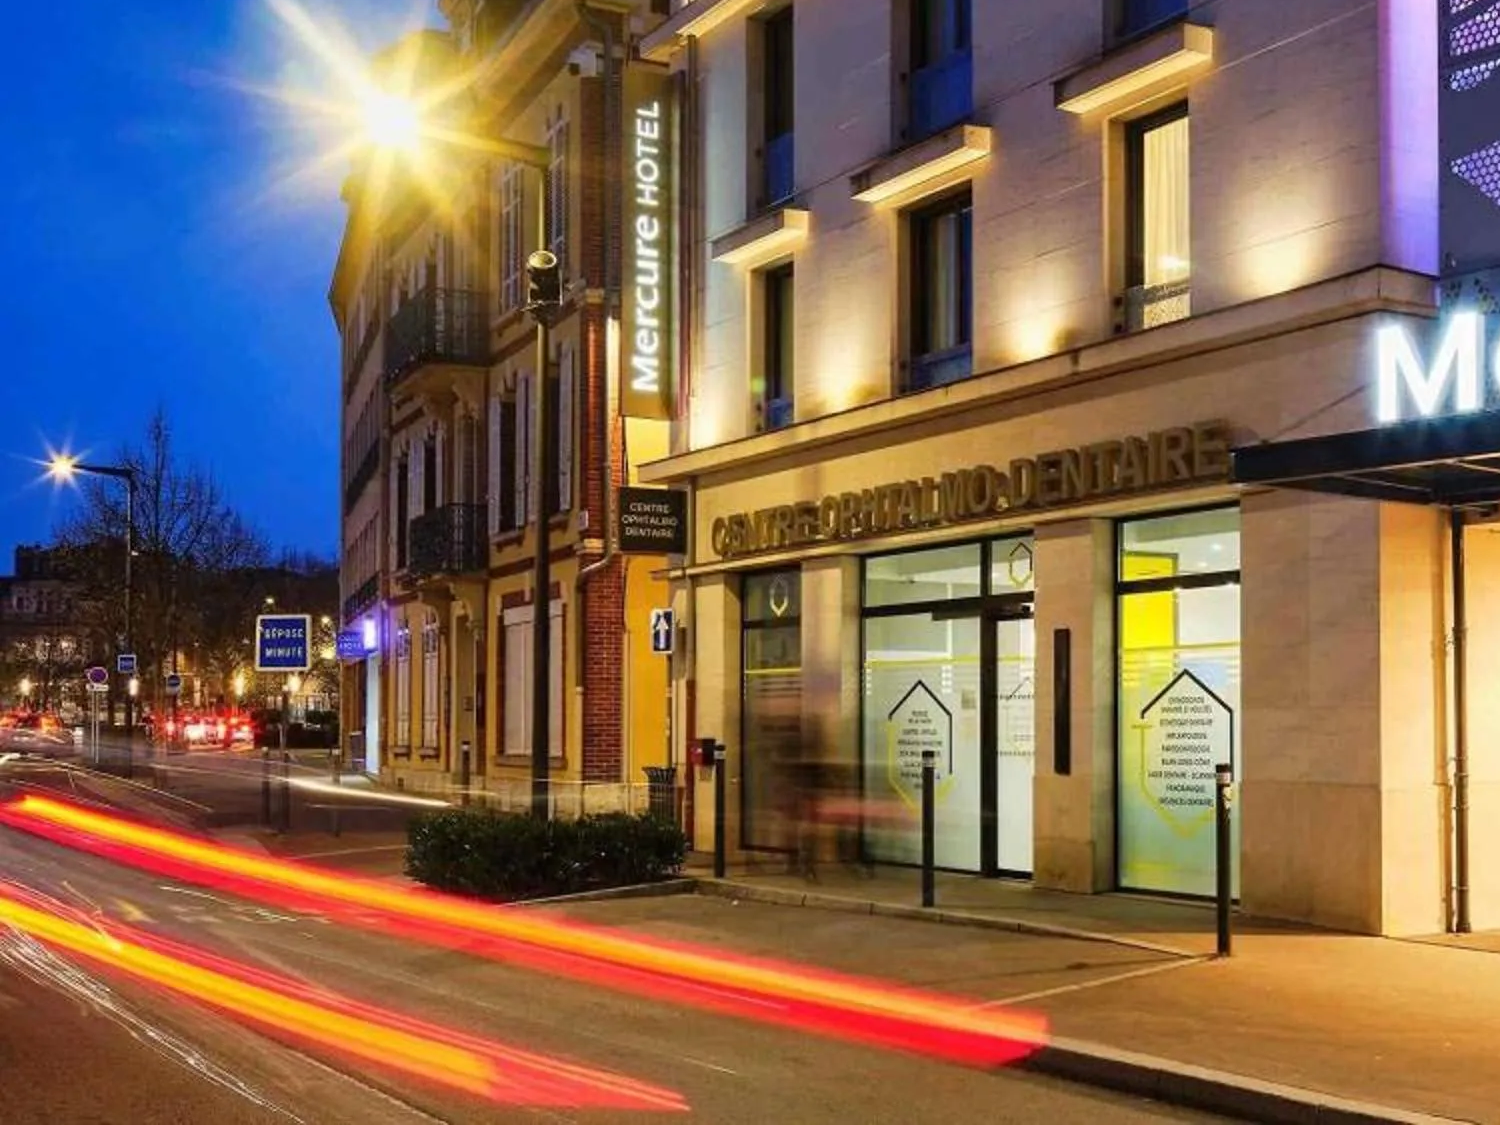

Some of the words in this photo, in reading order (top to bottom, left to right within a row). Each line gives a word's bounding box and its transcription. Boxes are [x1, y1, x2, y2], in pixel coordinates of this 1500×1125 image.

[636, 101, 659, 206] HOTEL
[632, 214, 660, 393] Mercure
[629, 502, 670, 514] CENTRE
